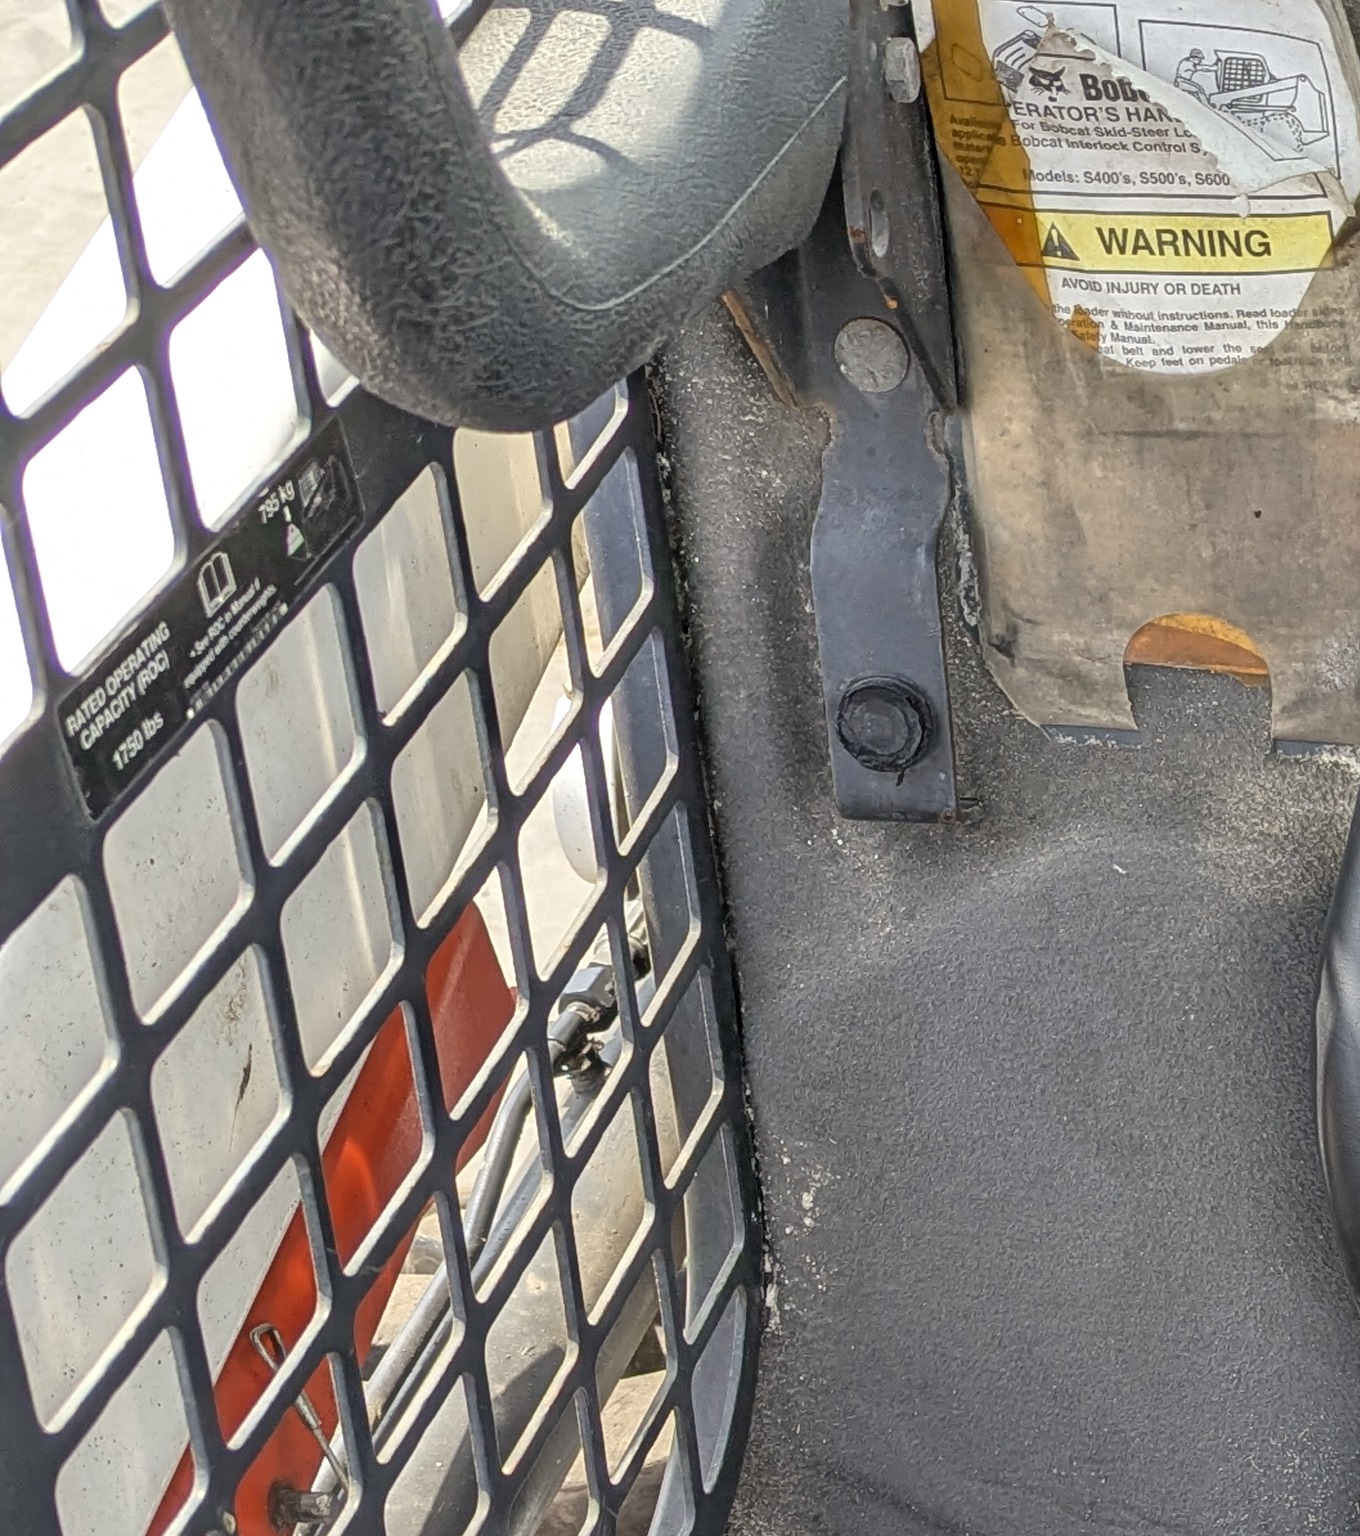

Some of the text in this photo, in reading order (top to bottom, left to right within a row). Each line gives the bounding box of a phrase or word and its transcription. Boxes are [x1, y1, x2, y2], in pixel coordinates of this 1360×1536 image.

[1040, 121, 1090, 138] Bobcat
[1094, 126, 1169, 138] Skid-Steer
[1011, 133, 1064, 149] Bobcat
[1066, 136, 1130, 151] Interlock
[1132, 139, 1186, 153] Control
[1190, 142, 1209, 157] S
[1022, 168, 1080, 184] Models:
[1083, 171, 1137, 187] S400's,
[1139, 172, 1192, 188] S500's,
[1095, 226, 1273, 258] WARNING
[1061, 276, 1242, 296] AVOID INJURY OR DEATH
[1111, 308, 1154, 321] without
[1157, 308, 1233, 321] instructions.
[1236, 309, 1267, 319] Read
[1270, 307, 1308, 319] loader
[1110, 320, 1119, 330] &
[1123, 320, 1199, 333] Maintenance
[1204, 319, 1251, 332] Manual,
[1256, 318, 1279, 330] this
[1110, 332, 1156, 344] Manual.
[1121, 345, 1145, 356] belt
[1151, 346, 1174, 356] and
[1182, 345, 1215, 354] lower
[1222, 343, 1242, 354] the
[1126, 357, 1157, 369] Keep
[1160, 357, 1184, 367] feet
[1188, 357, 1205, 366] on
[277, 479, 296, 504] kg
[65, 620, 171, 738] RATED OPERATING
[79, 680, 137, 751] CAPACITY
[136, 649, 171, 696] (ROC)
[112, 710, 165, 771] 1750 lbs
